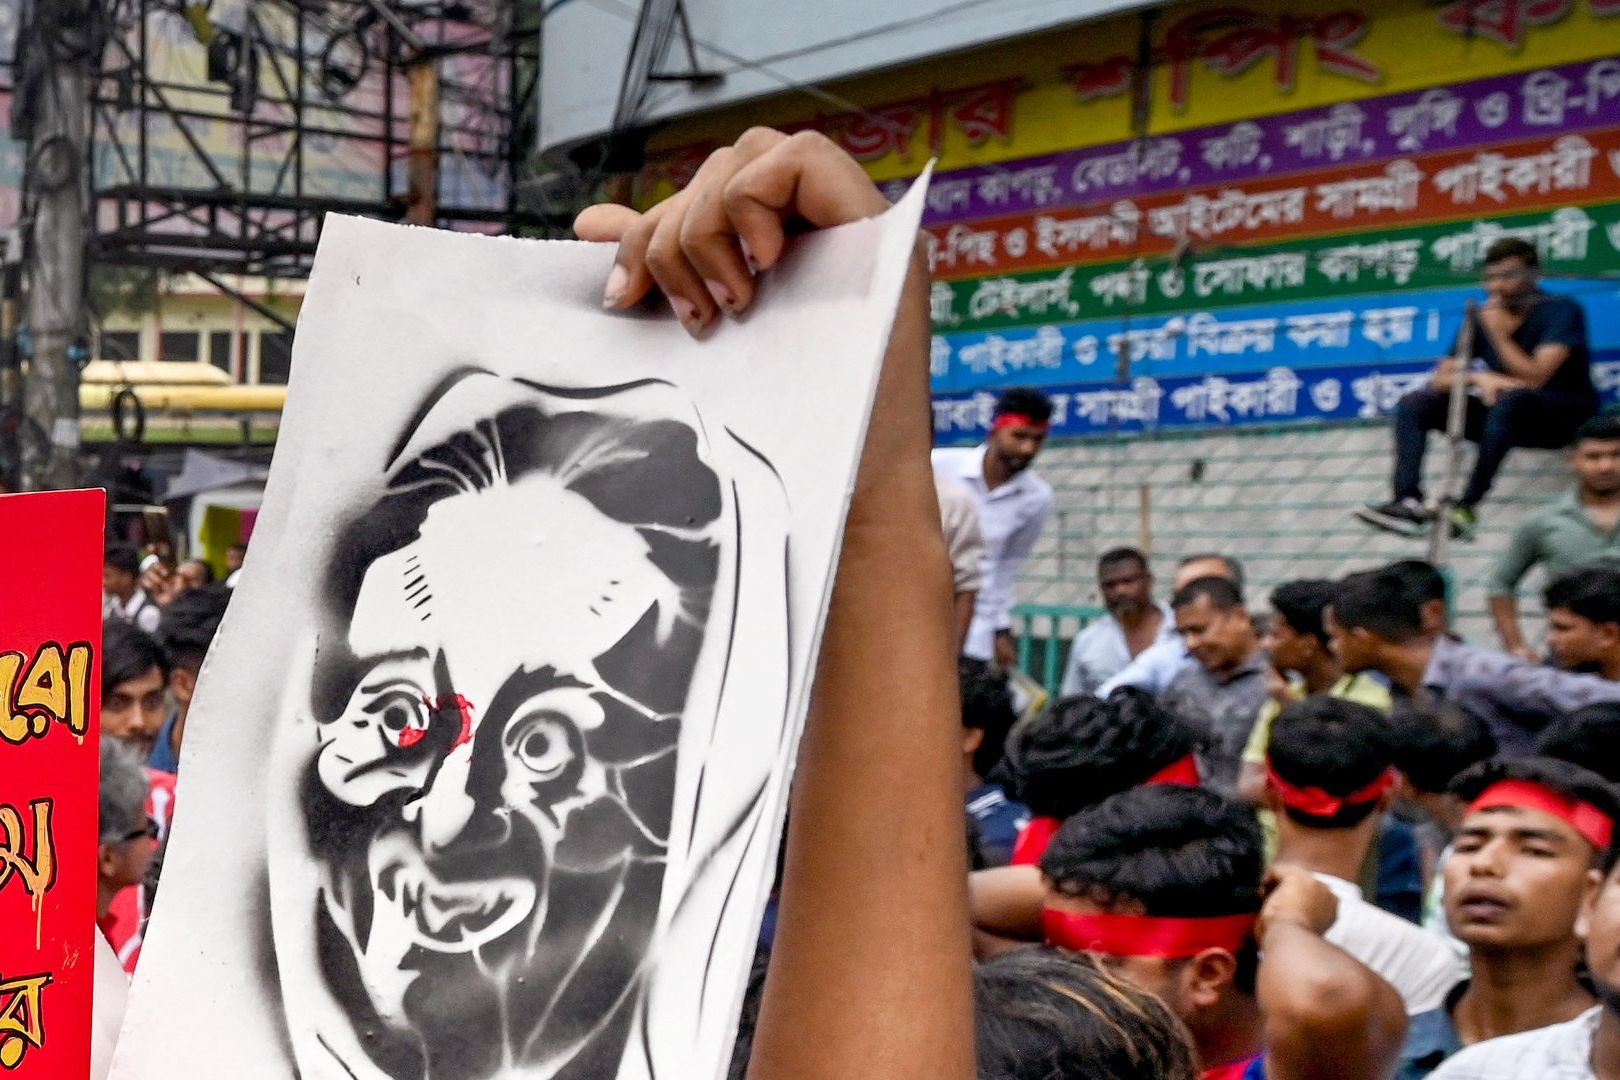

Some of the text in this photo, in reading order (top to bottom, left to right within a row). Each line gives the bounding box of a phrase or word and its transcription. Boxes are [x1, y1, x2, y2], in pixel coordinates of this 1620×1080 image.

[1475, 92, 1510, 128] ও
[1004, 227, 1028, 257] ও
[1432, 134, 1598, 204] পাইকারী
[959, 325, 1067, 376] পাইকারী
[1075, 334, 1098, 366] ও
[1173, 365, 1303, 422] পাইকারী
[1310, 377, 1342, 413] ও
